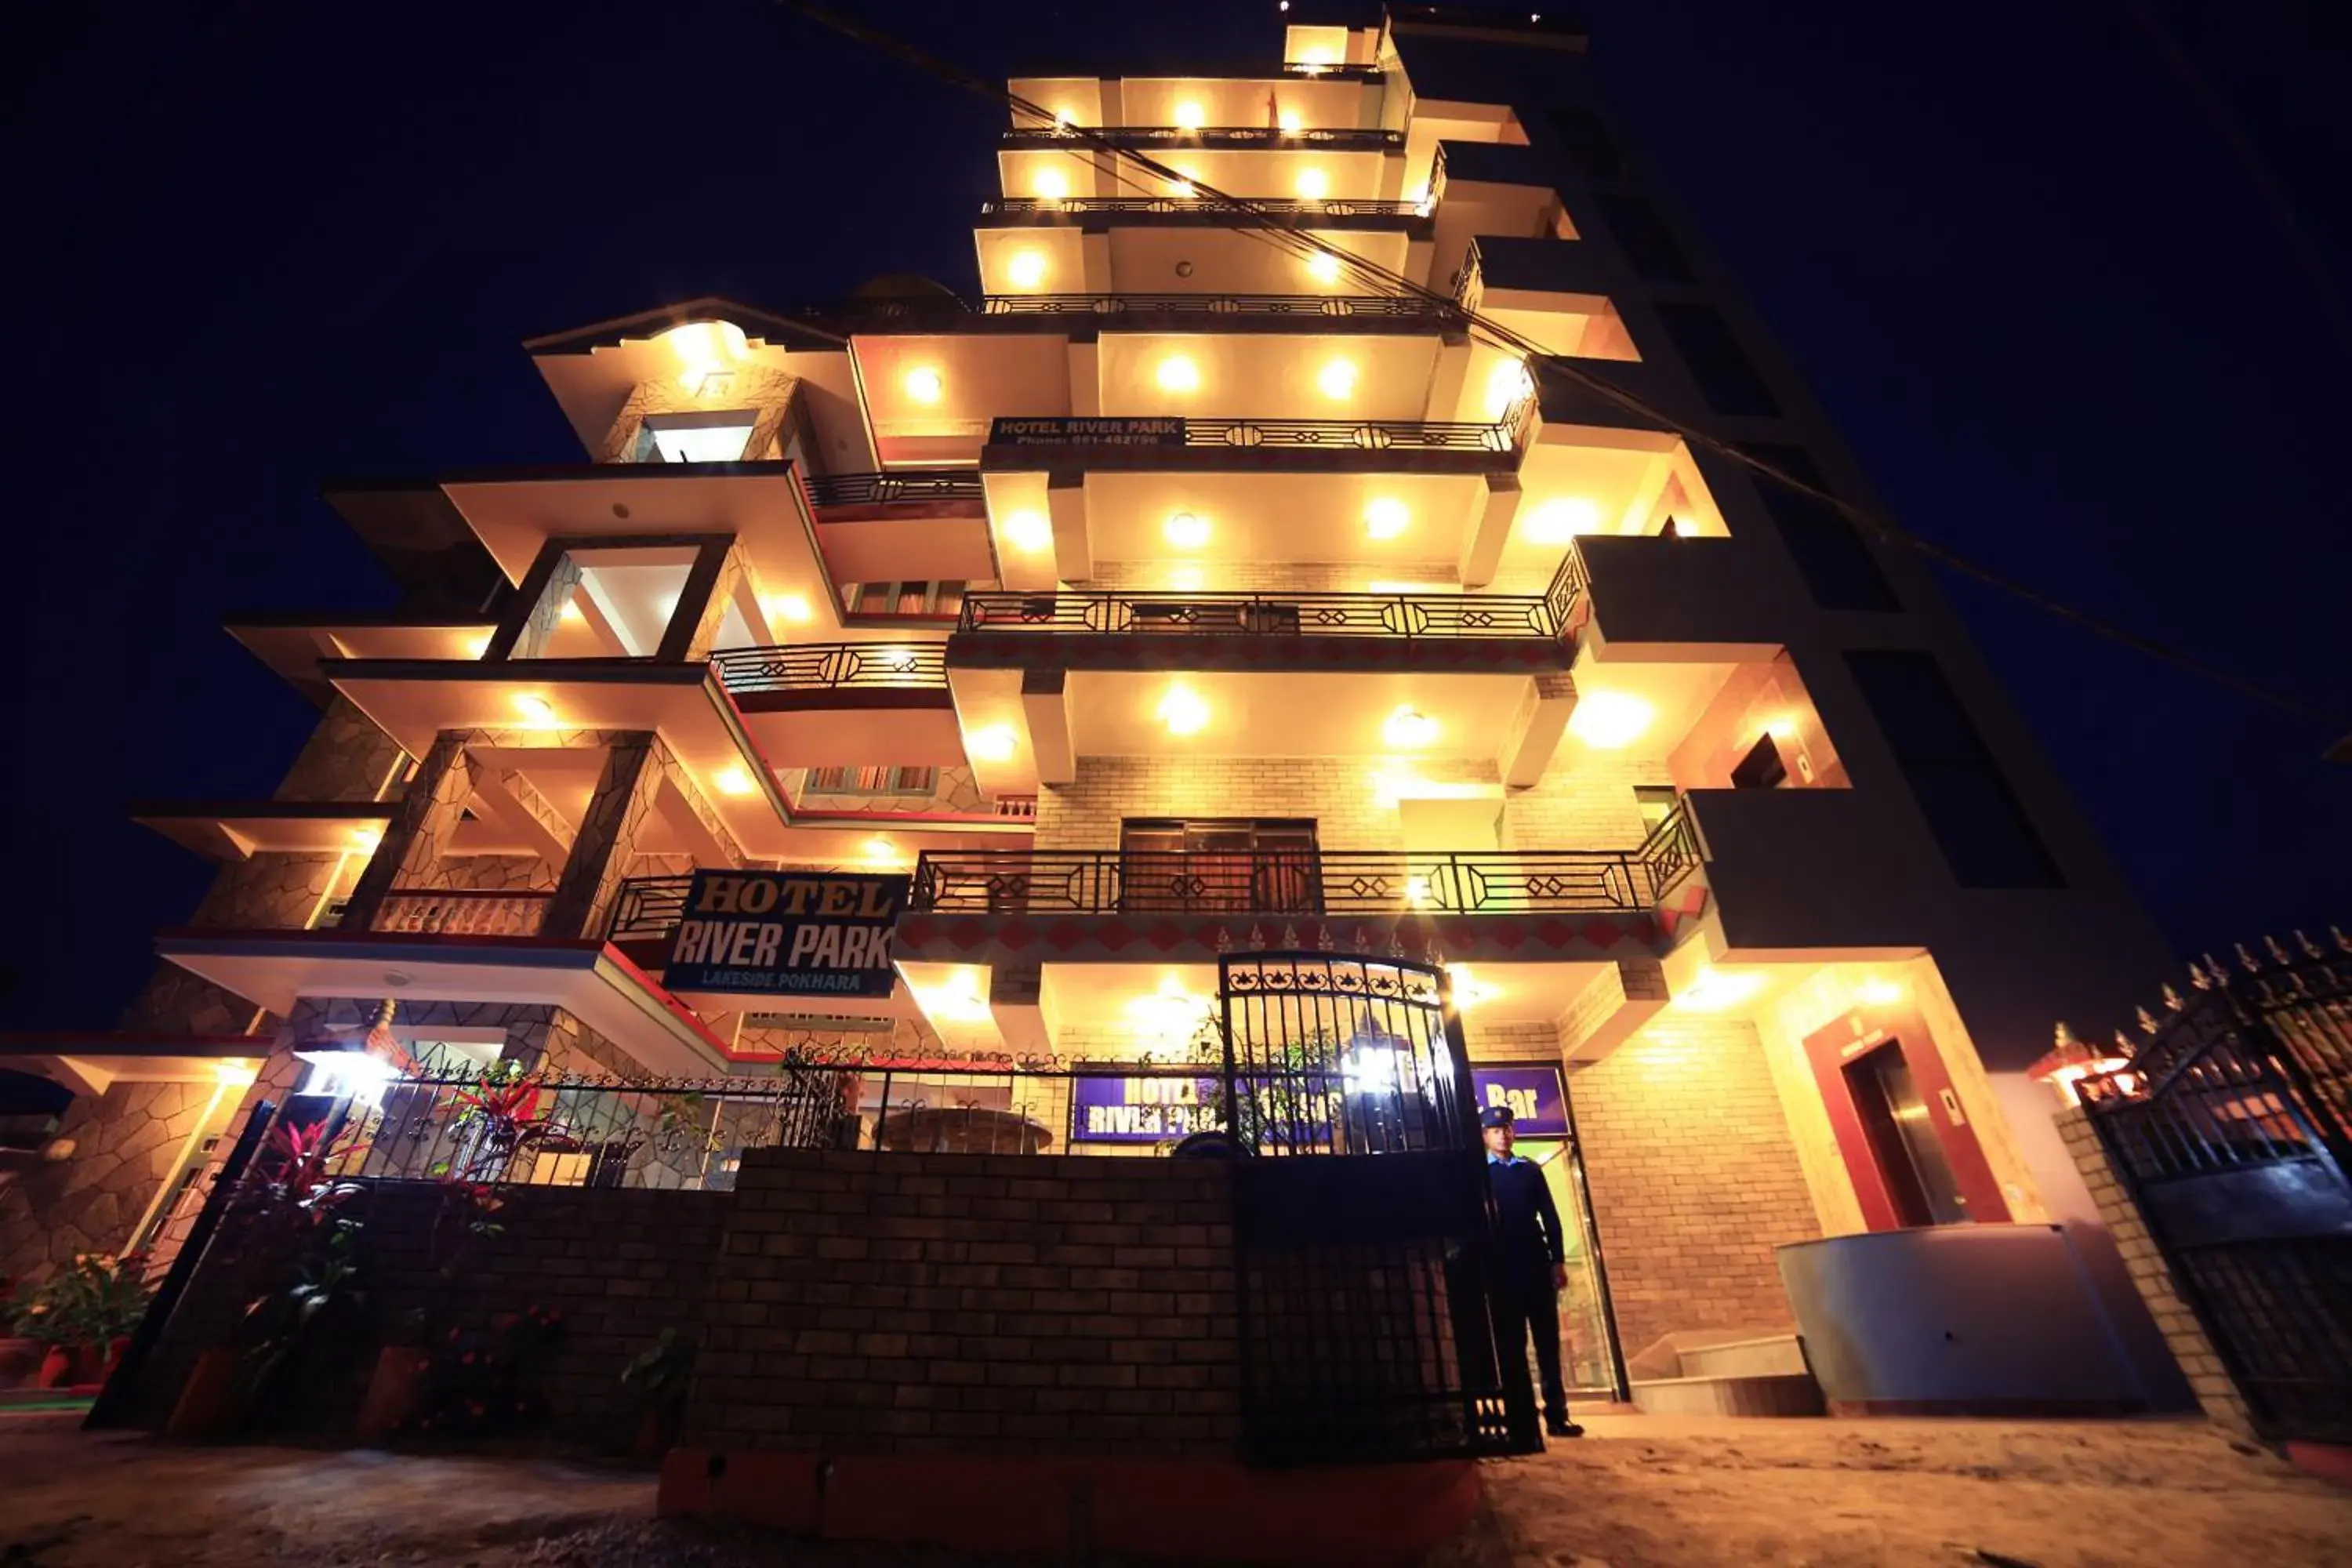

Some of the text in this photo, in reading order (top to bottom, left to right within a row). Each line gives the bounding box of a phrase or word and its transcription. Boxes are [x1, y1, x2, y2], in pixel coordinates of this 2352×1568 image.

[1000, 420, 1178, 434] HOTEL RIVER PARK
[695, 876, 894, 918] HOTEL
[672, 920, 897, 969] RIVER PARK
[701, 969, 861, 991] LAKESIDE POKHARA
[1486, 1083, 1538, 1120] Bar
